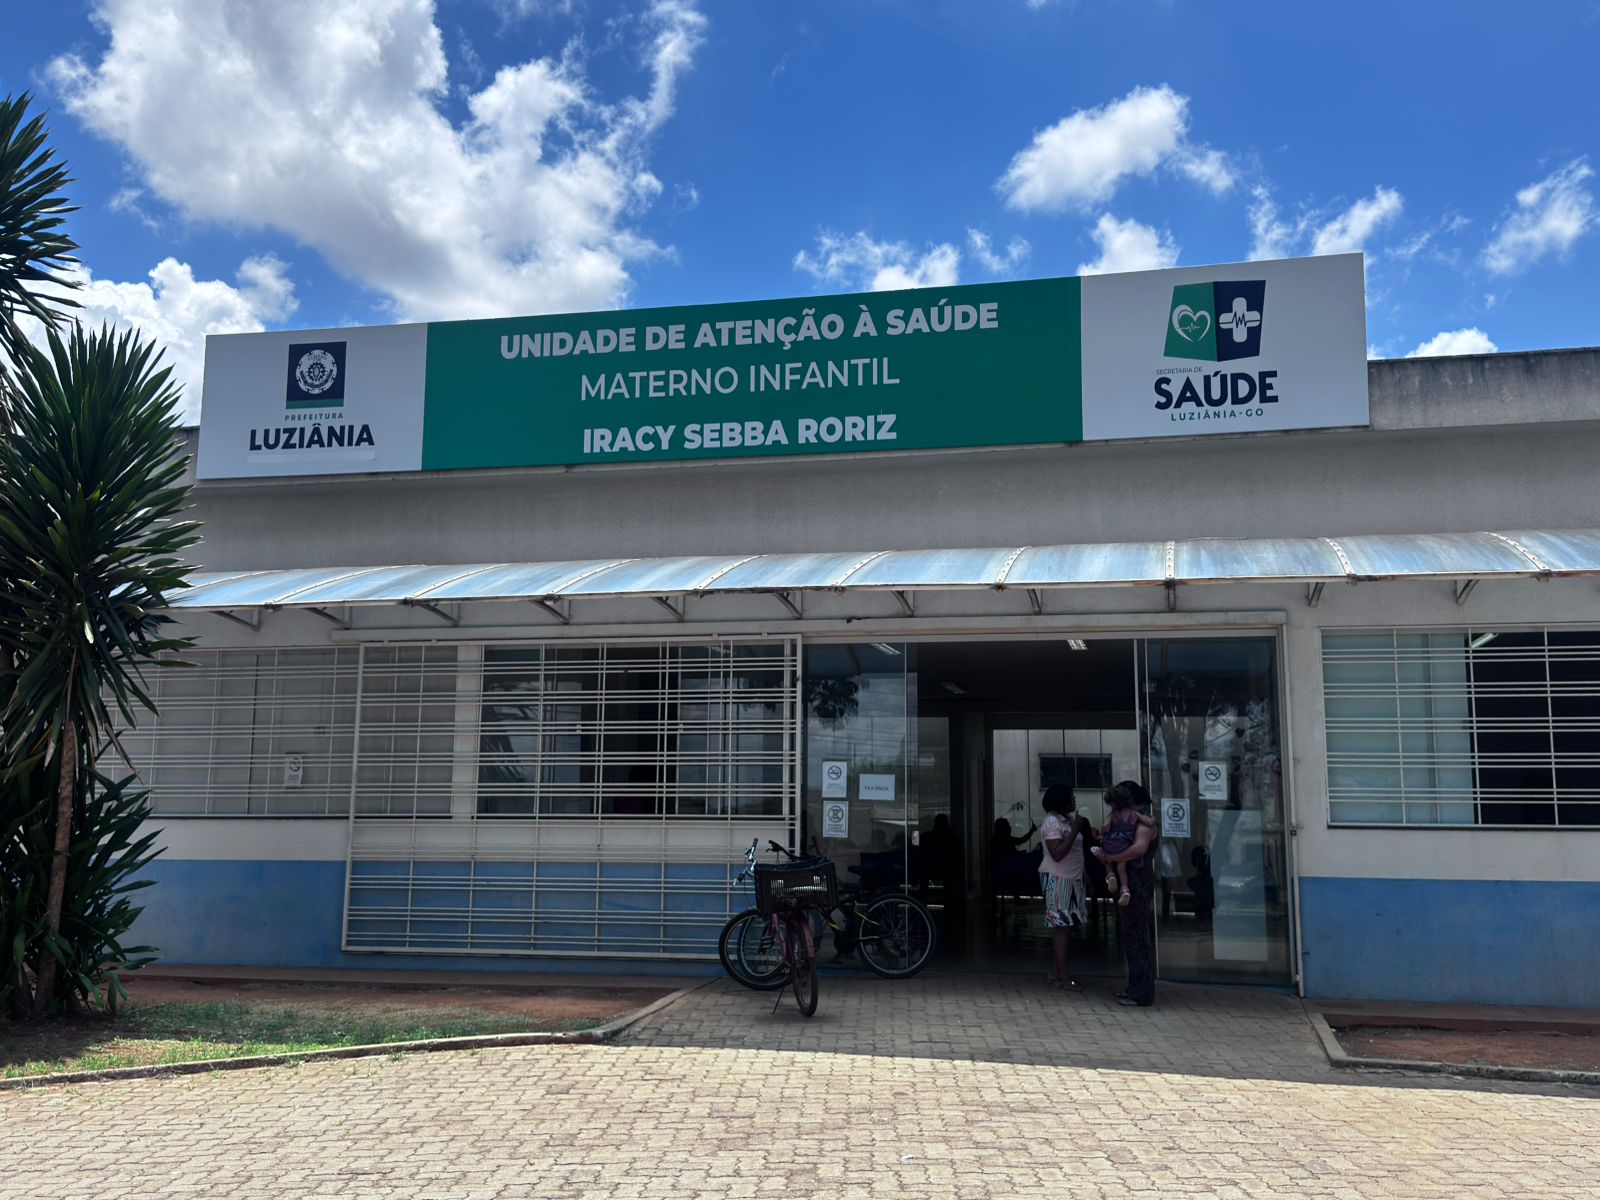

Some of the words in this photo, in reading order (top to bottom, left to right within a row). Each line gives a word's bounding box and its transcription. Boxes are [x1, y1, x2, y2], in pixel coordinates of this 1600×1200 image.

[500, 327, 636, 360] UNIDADE
[645, 324, 686, 351] DE
[693, 308, 845, 351] ATENÇÃO
[852, 304, 878, 338] À
[886, 298, 999, 336] SAÚDE
[581, 366, 739, 401] MATERNO
[749, 357, 900, 393] INFANTIL
[1156, 367, 1192, 375] SECRETARIA
[1154, 370, 1279, 410] SAÚDE
[285, 412, 344, 421] PREFEITURA
[1171, 408, 1264, 421] LUZIÂNIA-GO
[249, 423, 375, 451] LUZIÂNIA
[583, 425, 677, 454] IRACY
[683, 420, 789, 450] SEBBA
[797, 414, 897, 444] RORIZ
